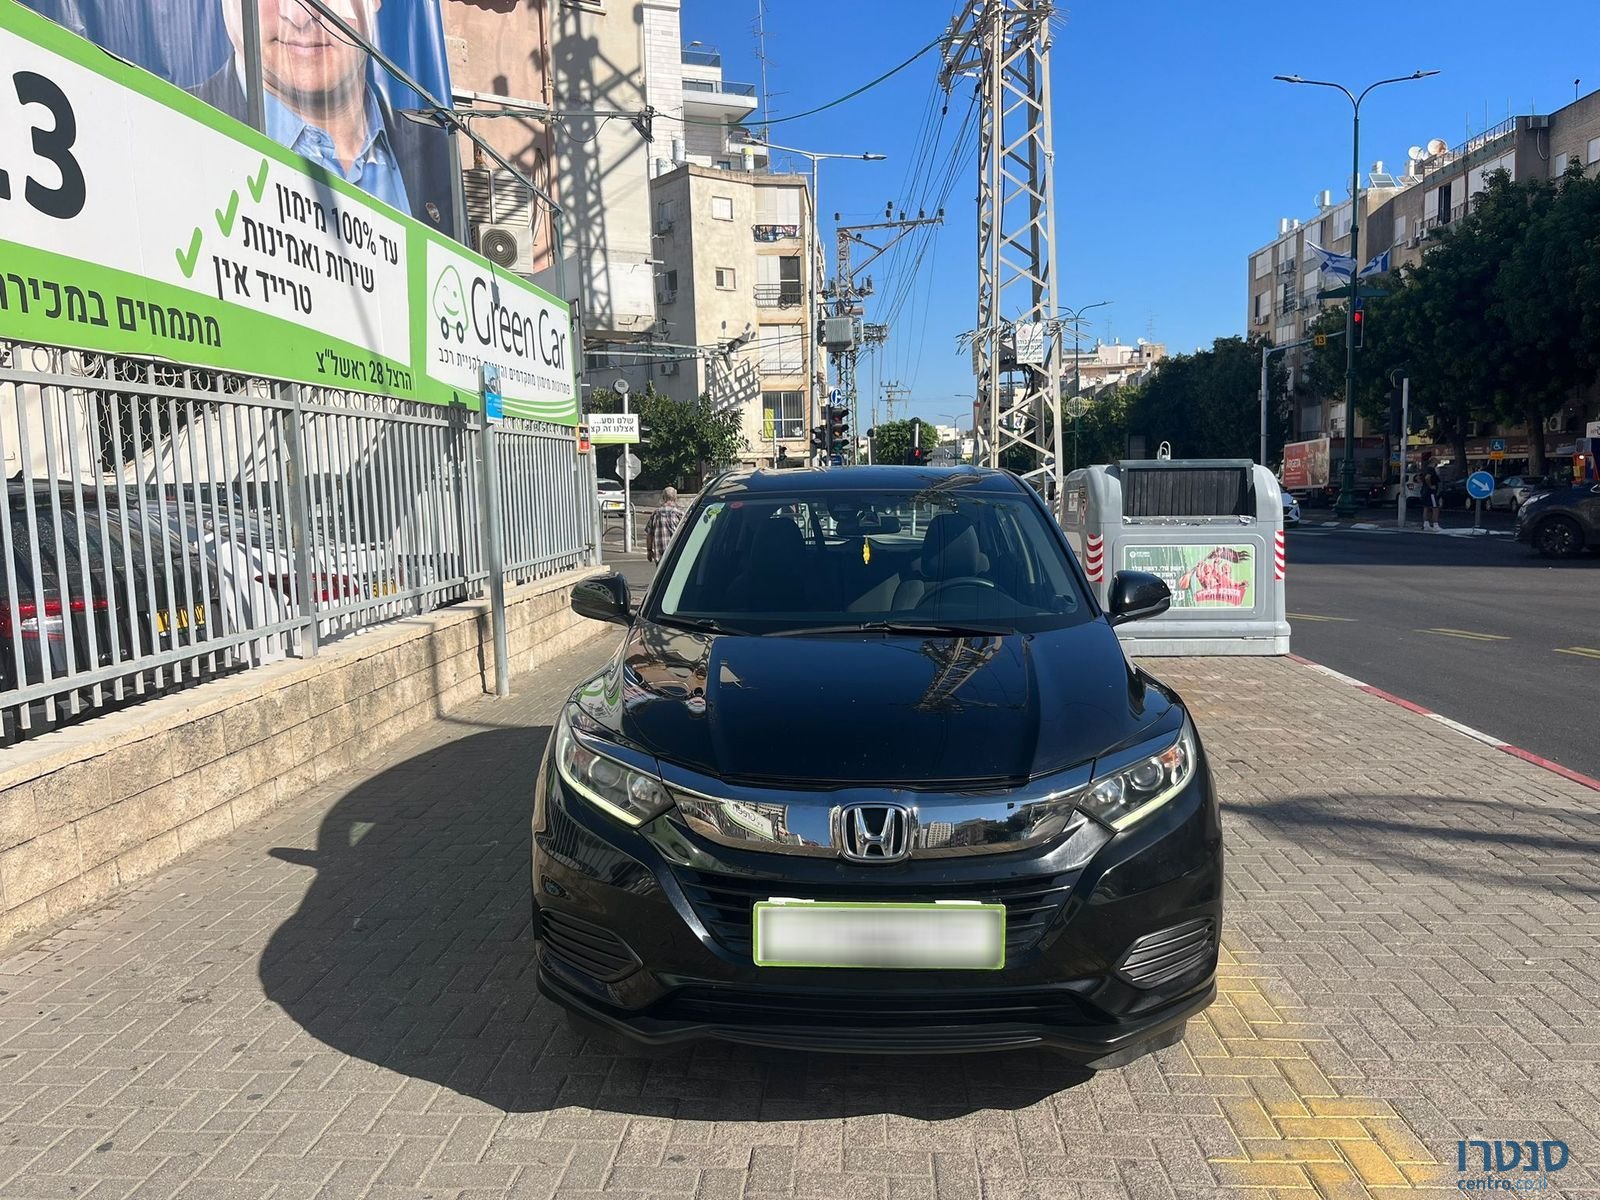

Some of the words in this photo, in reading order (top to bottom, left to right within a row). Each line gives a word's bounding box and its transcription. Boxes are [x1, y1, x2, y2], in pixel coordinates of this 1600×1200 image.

[0, 71, 86, 219] 3
[276, 183, 327, 233] מימון
[242, 216, 321, 274] ואמינות
[331, 207, 376, 256] 100%
[379, 234, 398, 266] עד
[213, 255, 251, 300] אין
[256, 269, 312, 314] טרייד
[325, 250, 374, 293] שירות
[116, 296, 221, 347] מתמחים
[471, 276, 536, 361] Green
[538, 308, 566, 370] Car
[369, 360, 384, 385] 28
[386, 362, 412, 391] הרצל
[438, 347, 455, 365] רכב
[509, 368, 536, 387] מתקדמים
[613, 425, 634, 433] אצלנו
[616, 416, 634, 425] שלם
